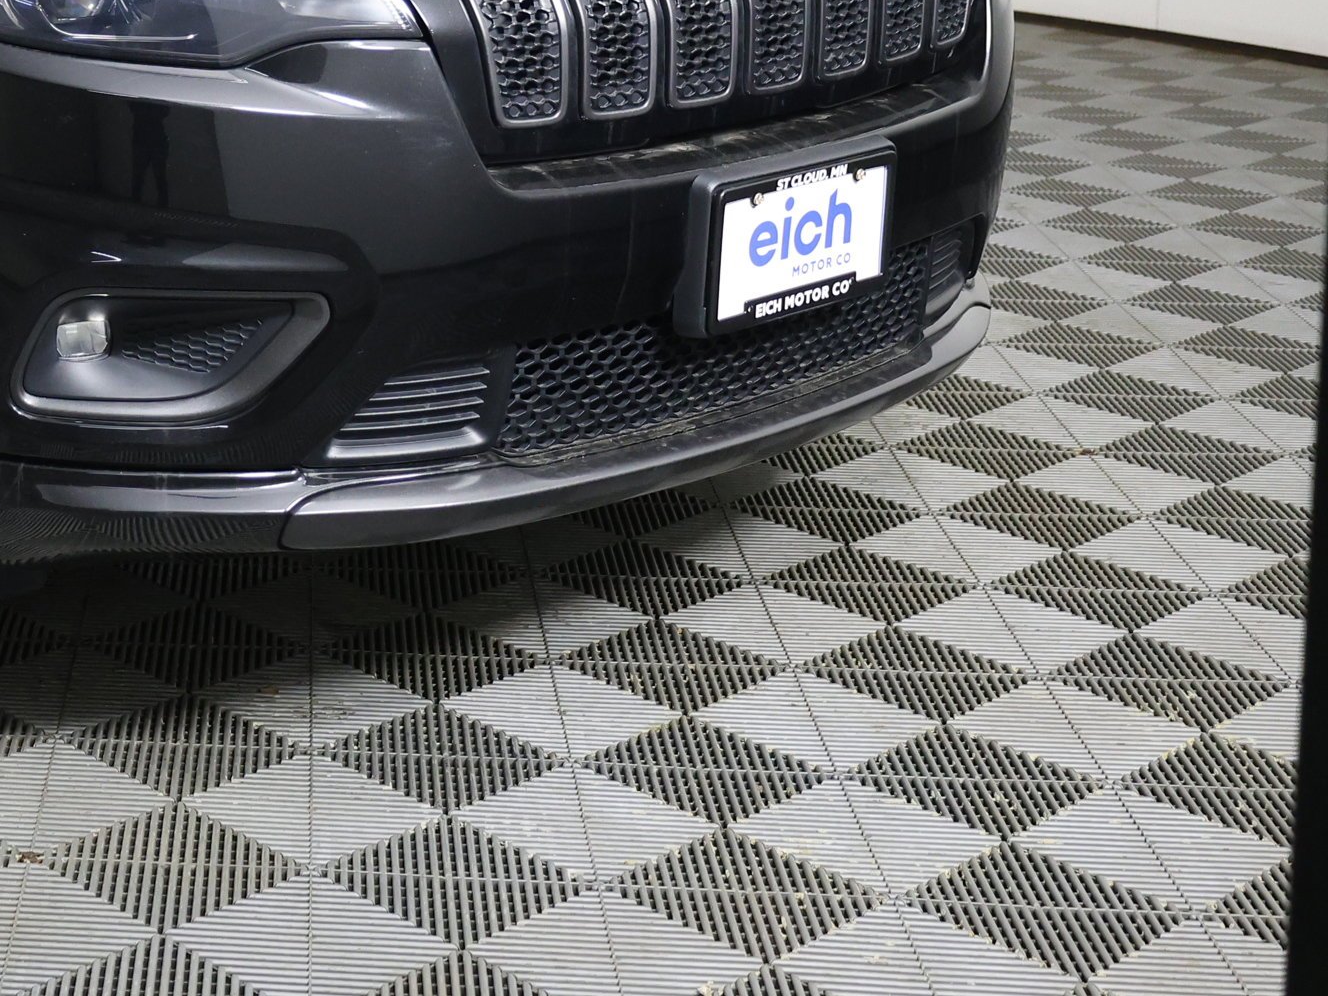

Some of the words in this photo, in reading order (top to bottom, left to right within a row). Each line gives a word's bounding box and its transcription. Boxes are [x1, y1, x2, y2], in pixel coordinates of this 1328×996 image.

[776, 177, 791, 192] ST
[831, 164, 849, 177] MN
[748, 188, 853, 267] eich
[791, 257, 832, 277] MOTOR
[836, 252, 851, 265] CO
[755, 298, 783, 318] EICH
[784, 285, 829, 309] MOTOR
